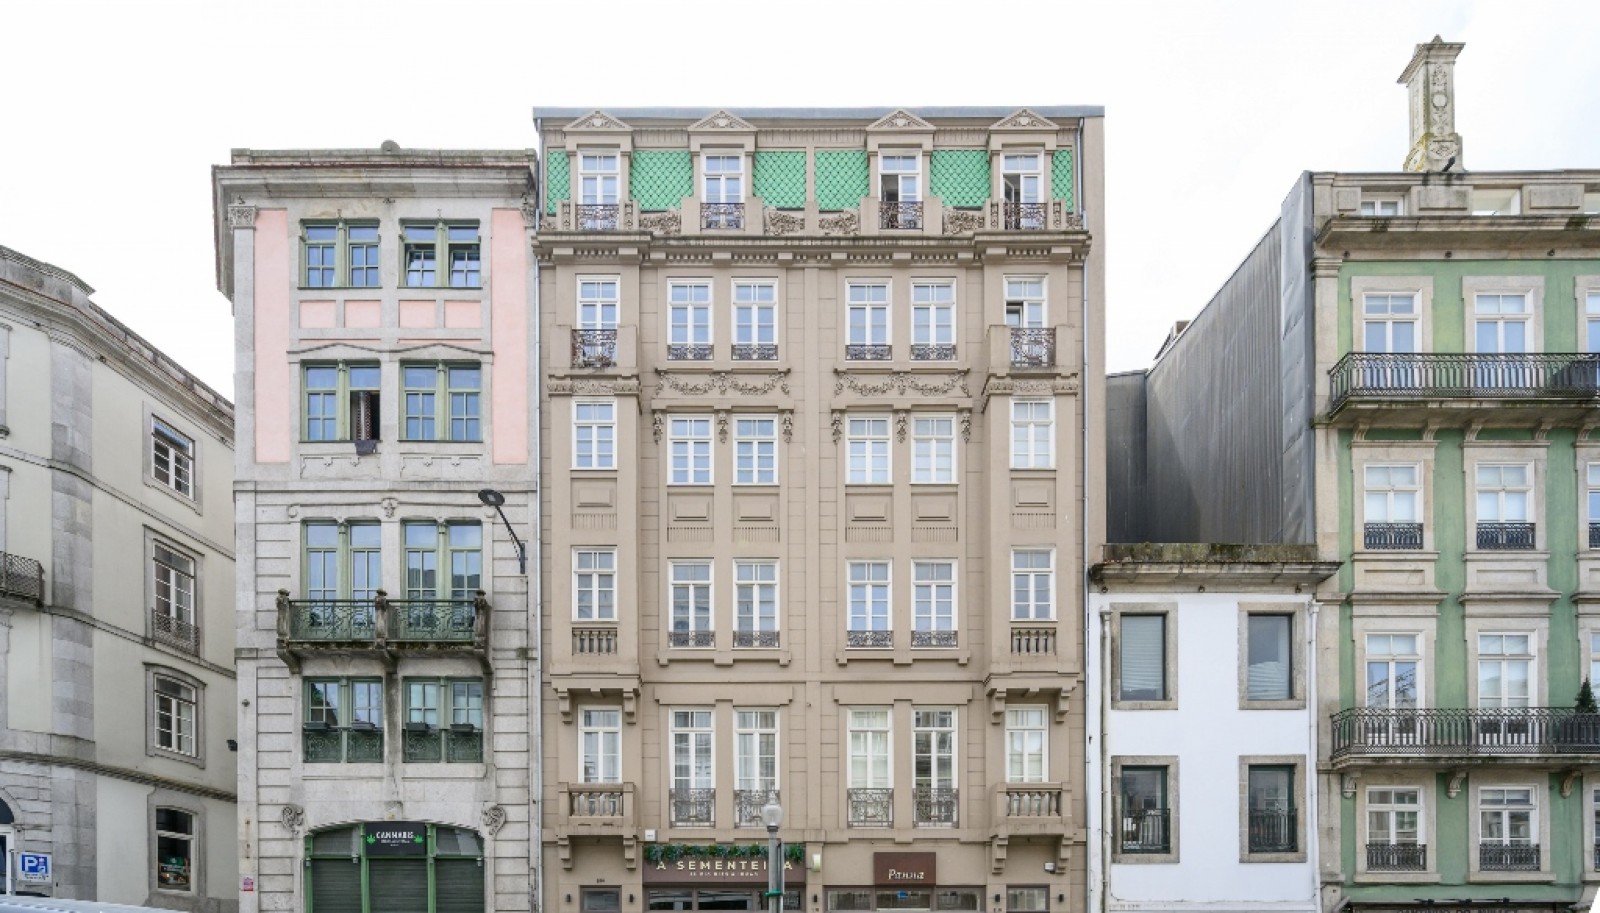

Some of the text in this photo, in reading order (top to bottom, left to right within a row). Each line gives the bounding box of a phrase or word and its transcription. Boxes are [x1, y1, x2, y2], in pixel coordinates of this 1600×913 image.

[24, 856, 38, 872] P
[656, 860, 793, 870] A SEMENTEIA
